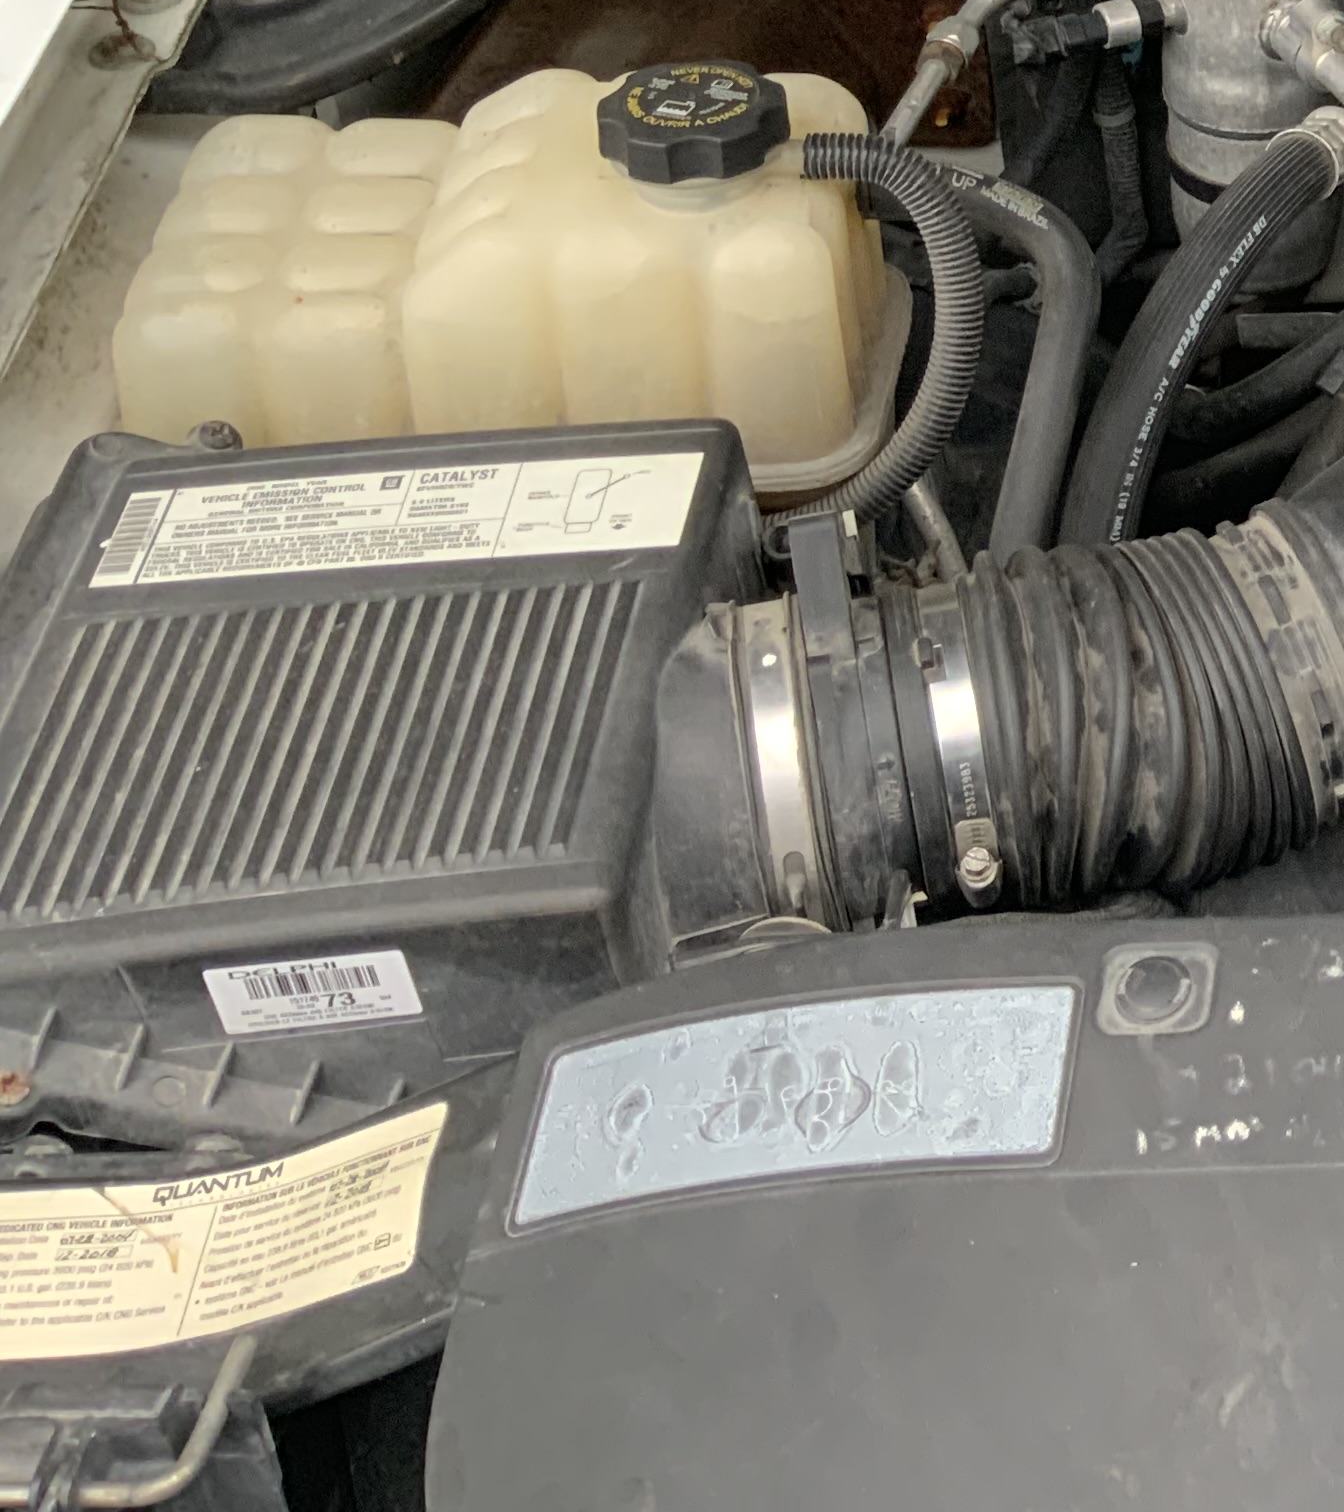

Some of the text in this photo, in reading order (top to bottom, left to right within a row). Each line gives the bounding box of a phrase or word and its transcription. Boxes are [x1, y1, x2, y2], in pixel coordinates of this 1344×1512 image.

[952, 172, 978, 190] UP
[1229, 234, 1255, 268] FLEX
[1168, 279, 1223, 371] GOODYEAR
[1153, 376, 1170, 403] A/C
[1137, 406, 1158, 442] HOSE
[1129, 446, 1143, 469] 3/4
[419, 468, 499, 484] CATALYST
[201, 492, 249, 504] VEHICLE
[252, 487, 309, 501] EMISSION
[313, 482, 366, 495] CONTROL
[241, 495, 323, 509] INFORMATION
[960, 761, 978, 818] 25323983
[227, 960, 337, 980] DELPHI
[152, 1161, 285, 1207] QUANTUM
[0, 1223, 43, 1233] EDICATED
[68, 1218, 108, 1230] VEHICLE
[110, 1213, 175, 1229] INFORMATION
